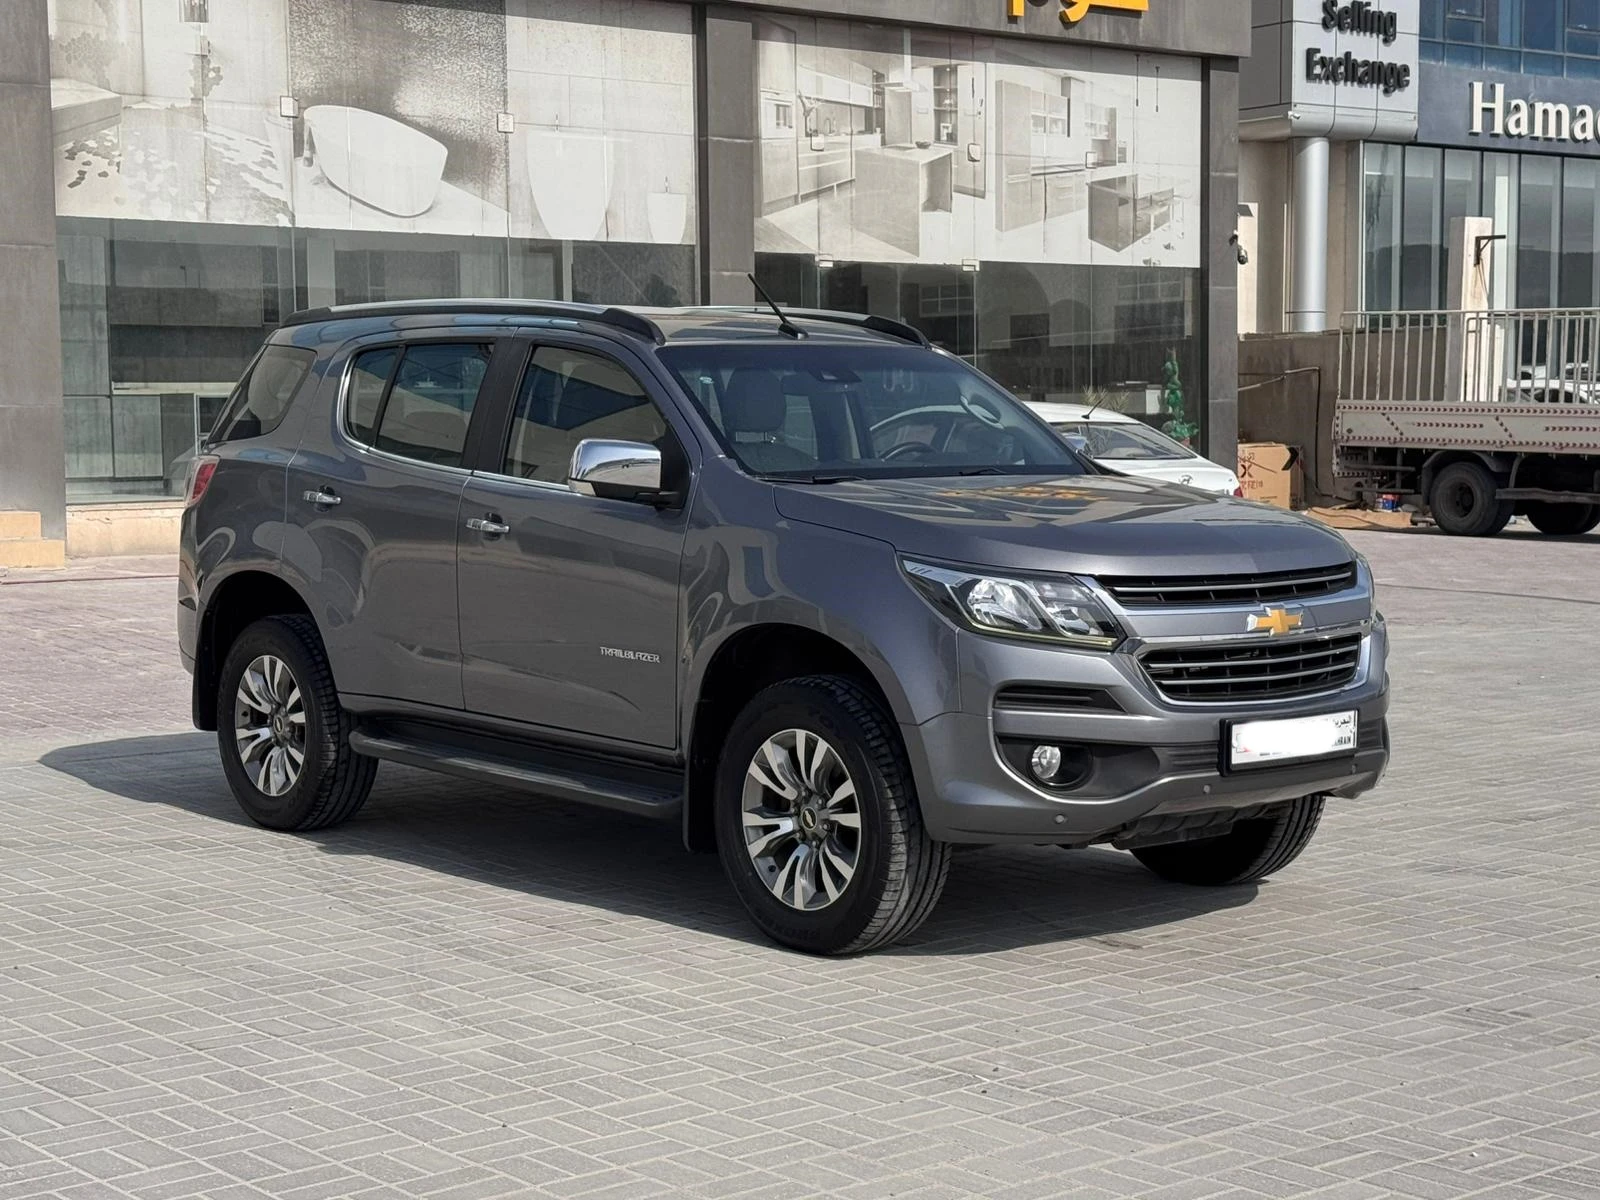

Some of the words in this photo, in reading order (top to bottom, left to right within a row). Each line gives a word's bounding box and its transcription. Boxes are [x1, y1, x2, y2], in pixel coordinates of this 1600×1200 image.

[1322, 0, 1397, 45] Selling
[1306, 47, 1410, 96] Exchange
[599, 646, 661, 663] TRAILBLAZER
